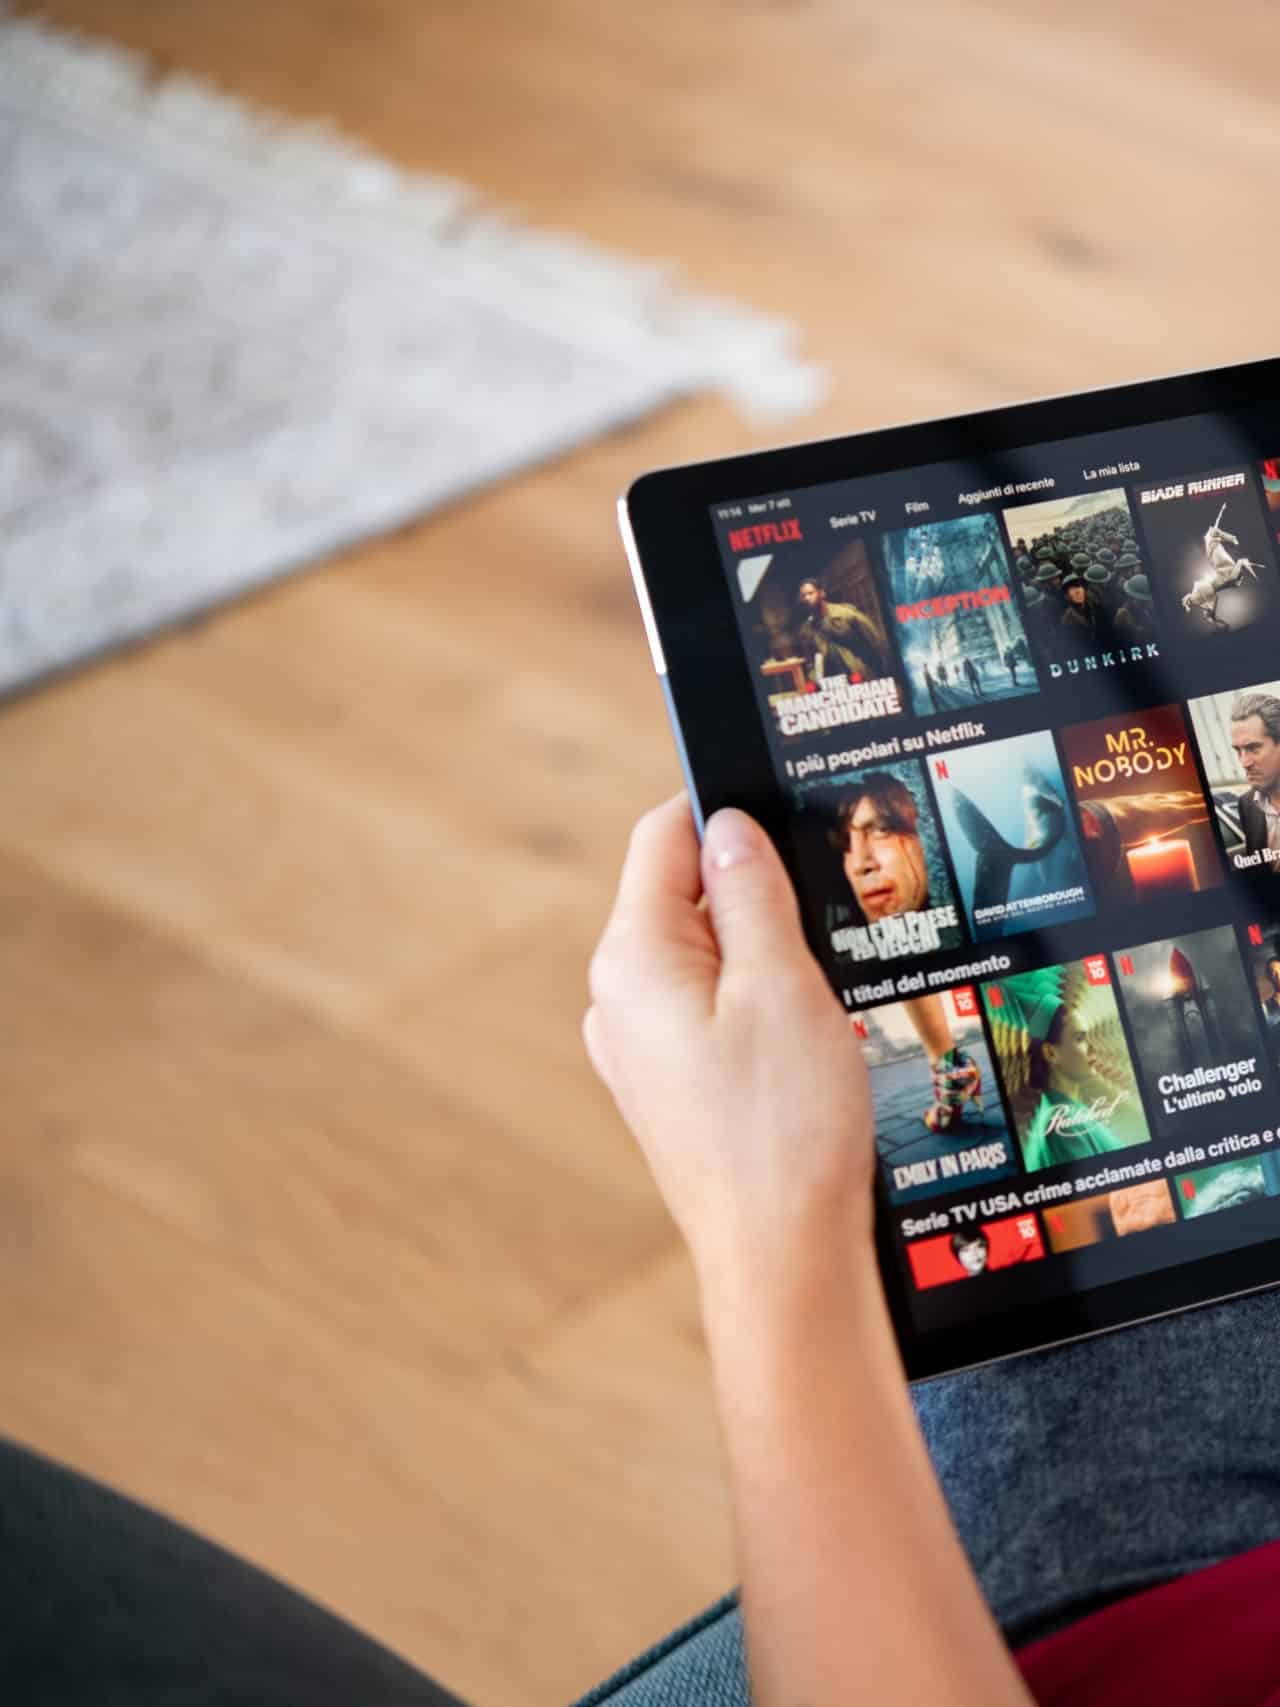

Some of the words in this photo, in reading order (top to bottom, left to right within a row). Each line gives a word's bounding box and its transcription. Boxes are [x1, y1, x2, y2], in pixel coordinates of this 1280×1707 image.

[1083, 467, 1097, 481] La
[1097, 464, 1118, 478] mia
[1118, 460, 1141, 475] lista
[1140, 484, 1184, 504] BLADE
[1187, 472, 1245, 496] RUNNER
[905, 501, 929, 515] Film
[958, 488, 1002, 505] Aggiunti
[1003, 485, 1014, 497] di
[1015, 477, 1054, 495] recente
[728, 518, 804, 552] NETFLIX
[829, 515, 859, 529] Serie
[859, 510, 877, 523] TV
[896, 584, 1010, 624] INCEPTION
[1049, 643, 1160, 678] DUNKIRK
[776, 677, 897, 716] MANCHURIAN
[780, 694, 902, 736] CANDIDATE
[785, 759, 794, 777] I
[795, 754, 825, 779] più
[827, 737, 900, 771] popolari
[902, 733, 925, 751] su
[926, 721, 985, 748] Netflix
[1105, 727, 1154, 753] MR.
[1073, 743, 1185, 788] NOBODY
[1233, 850, 1262, 869] Quei
[974, 904, 1005, 919] DAVID
[1006, 886, 1084, 912] ATTENBOROUGH
[843, 989, 852, 1006] I
[852, 978, 895, 1003] titoli
[897, 971, 926, 993] del
[927, 955, 1011, 986] momento
[1090, 967, 1105, 980] 10
[1158, 1057, 1256, 1094] Challenger
[1163, 1088, 1226, 1114] L'ultimo
[1228, 1077, 1262, 1097] volo
[893, 1159, 938, 1190] EMILY
[939, 1154, 960, 1178] IN
[959, 1142, 1007, 1174] PARIS
[901, 1211, 950, 1237] Serie
[950, 1202, 977, 1224] TV
[979, 1194, 1023, 1217] USA
[1023, 1181, 1073, 1204] crime
[1074, 1159, 1163, 1192] acclamate
[1164, 1145, 1207, 1169] dalla
[1208, 1132, 1260, 1157] critica
[1262, 1129, 1274, 1143] e
